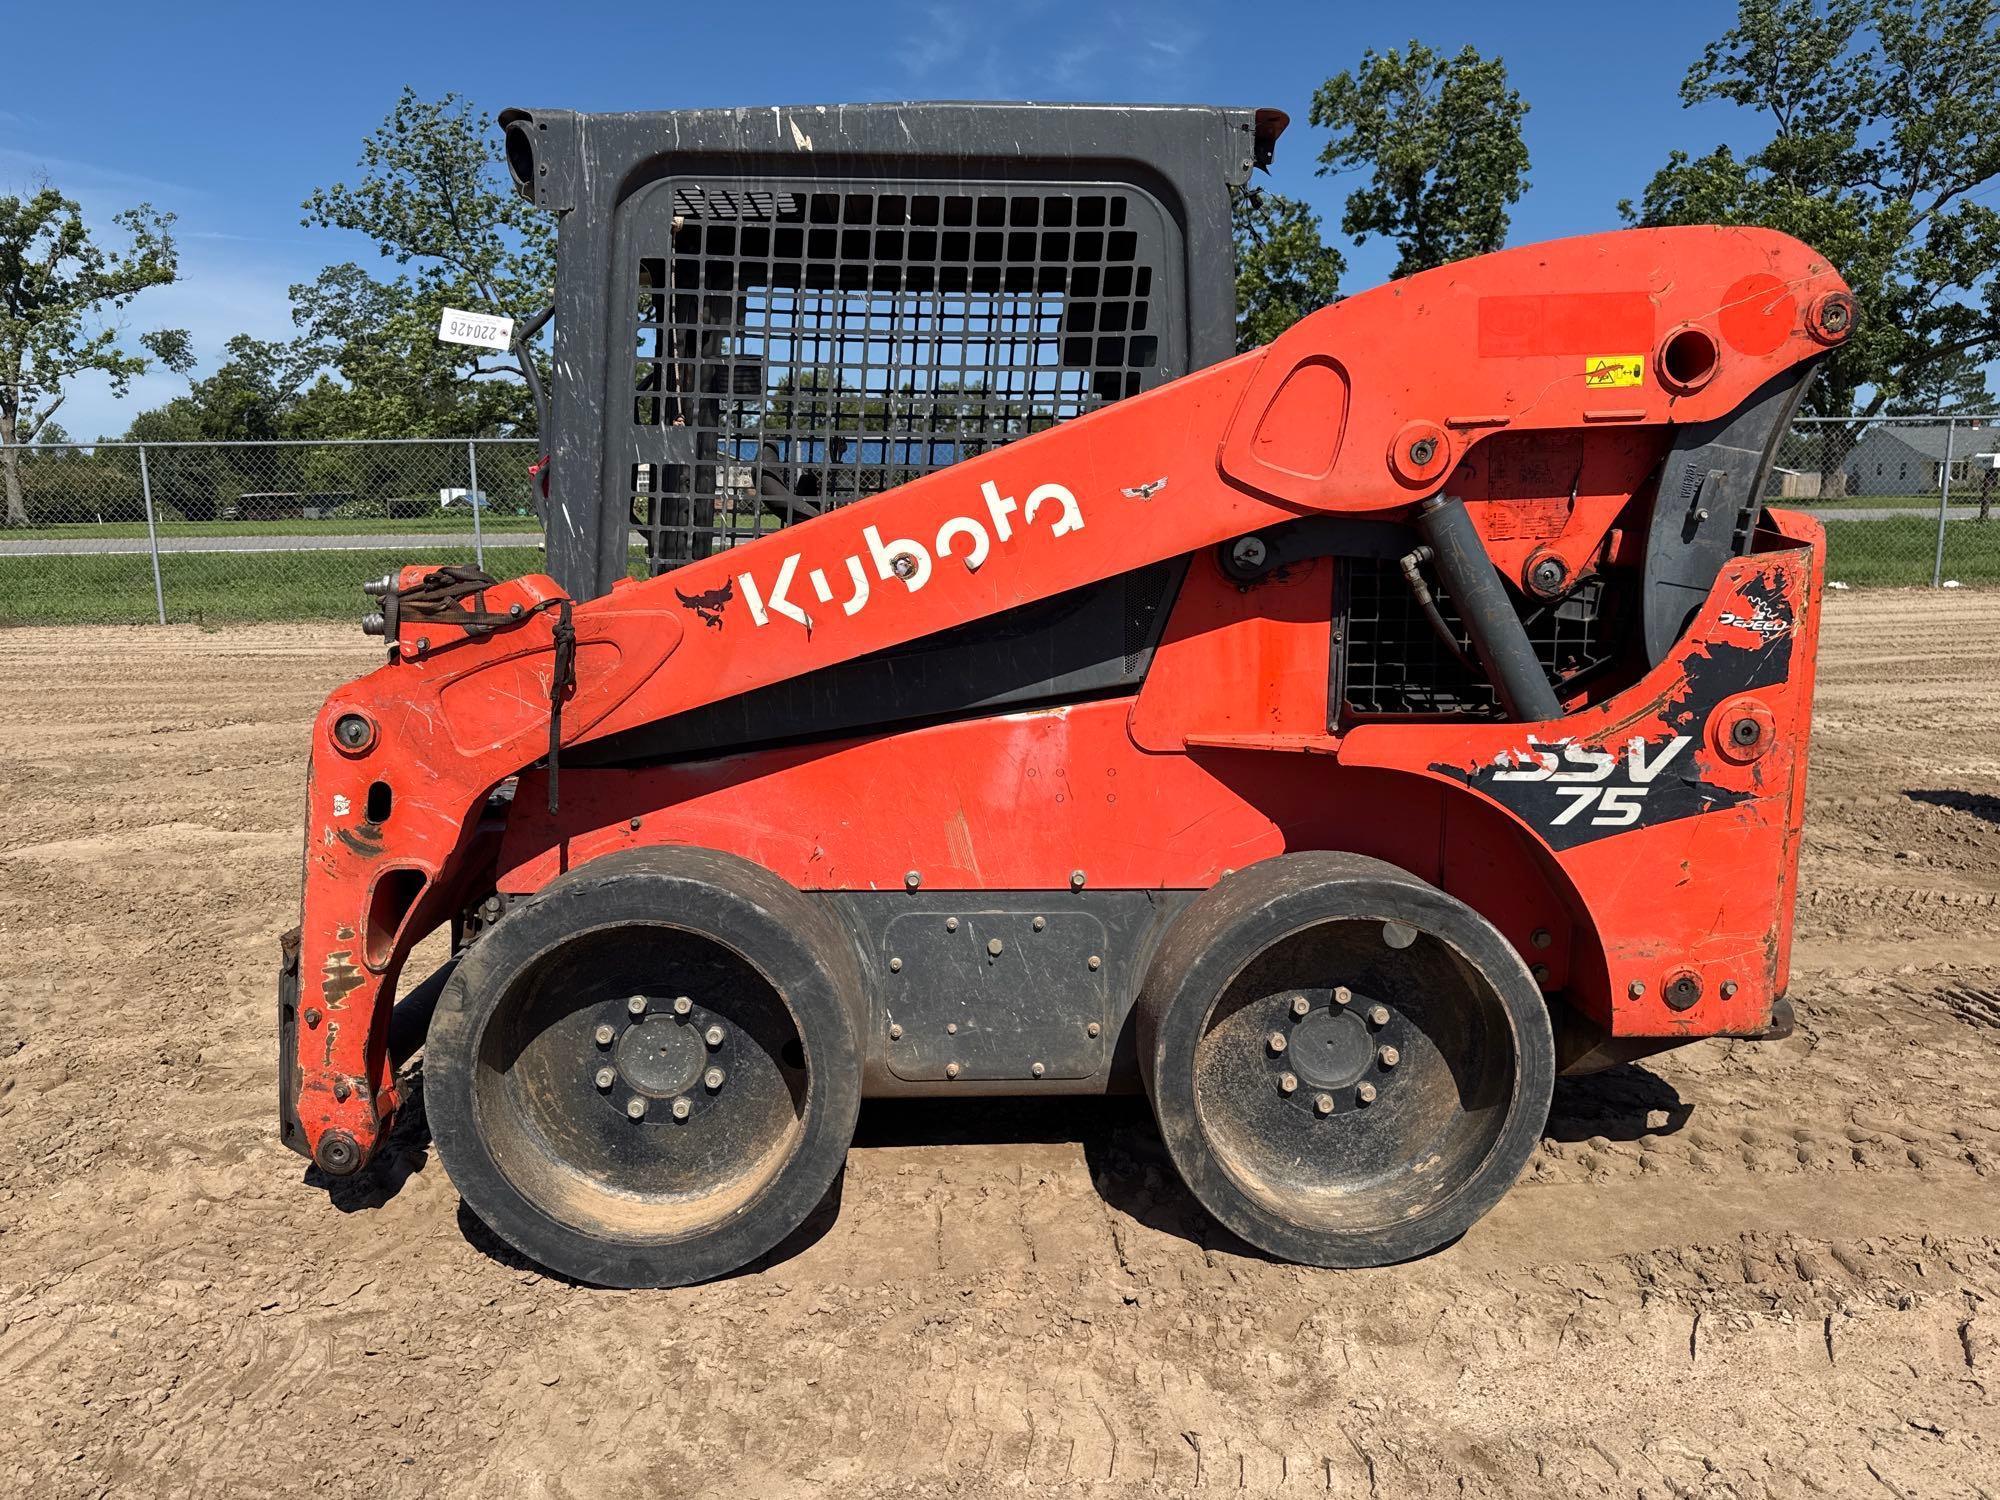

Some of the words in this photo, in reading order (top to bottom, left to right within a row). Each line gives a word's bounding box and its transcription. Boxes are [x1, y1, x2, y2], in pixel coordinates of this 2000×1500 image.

[450, 321, 497, 340] 220426
[738, 480, 1085, 630] Kubota
[1549, 787, 1649, 826] 75
